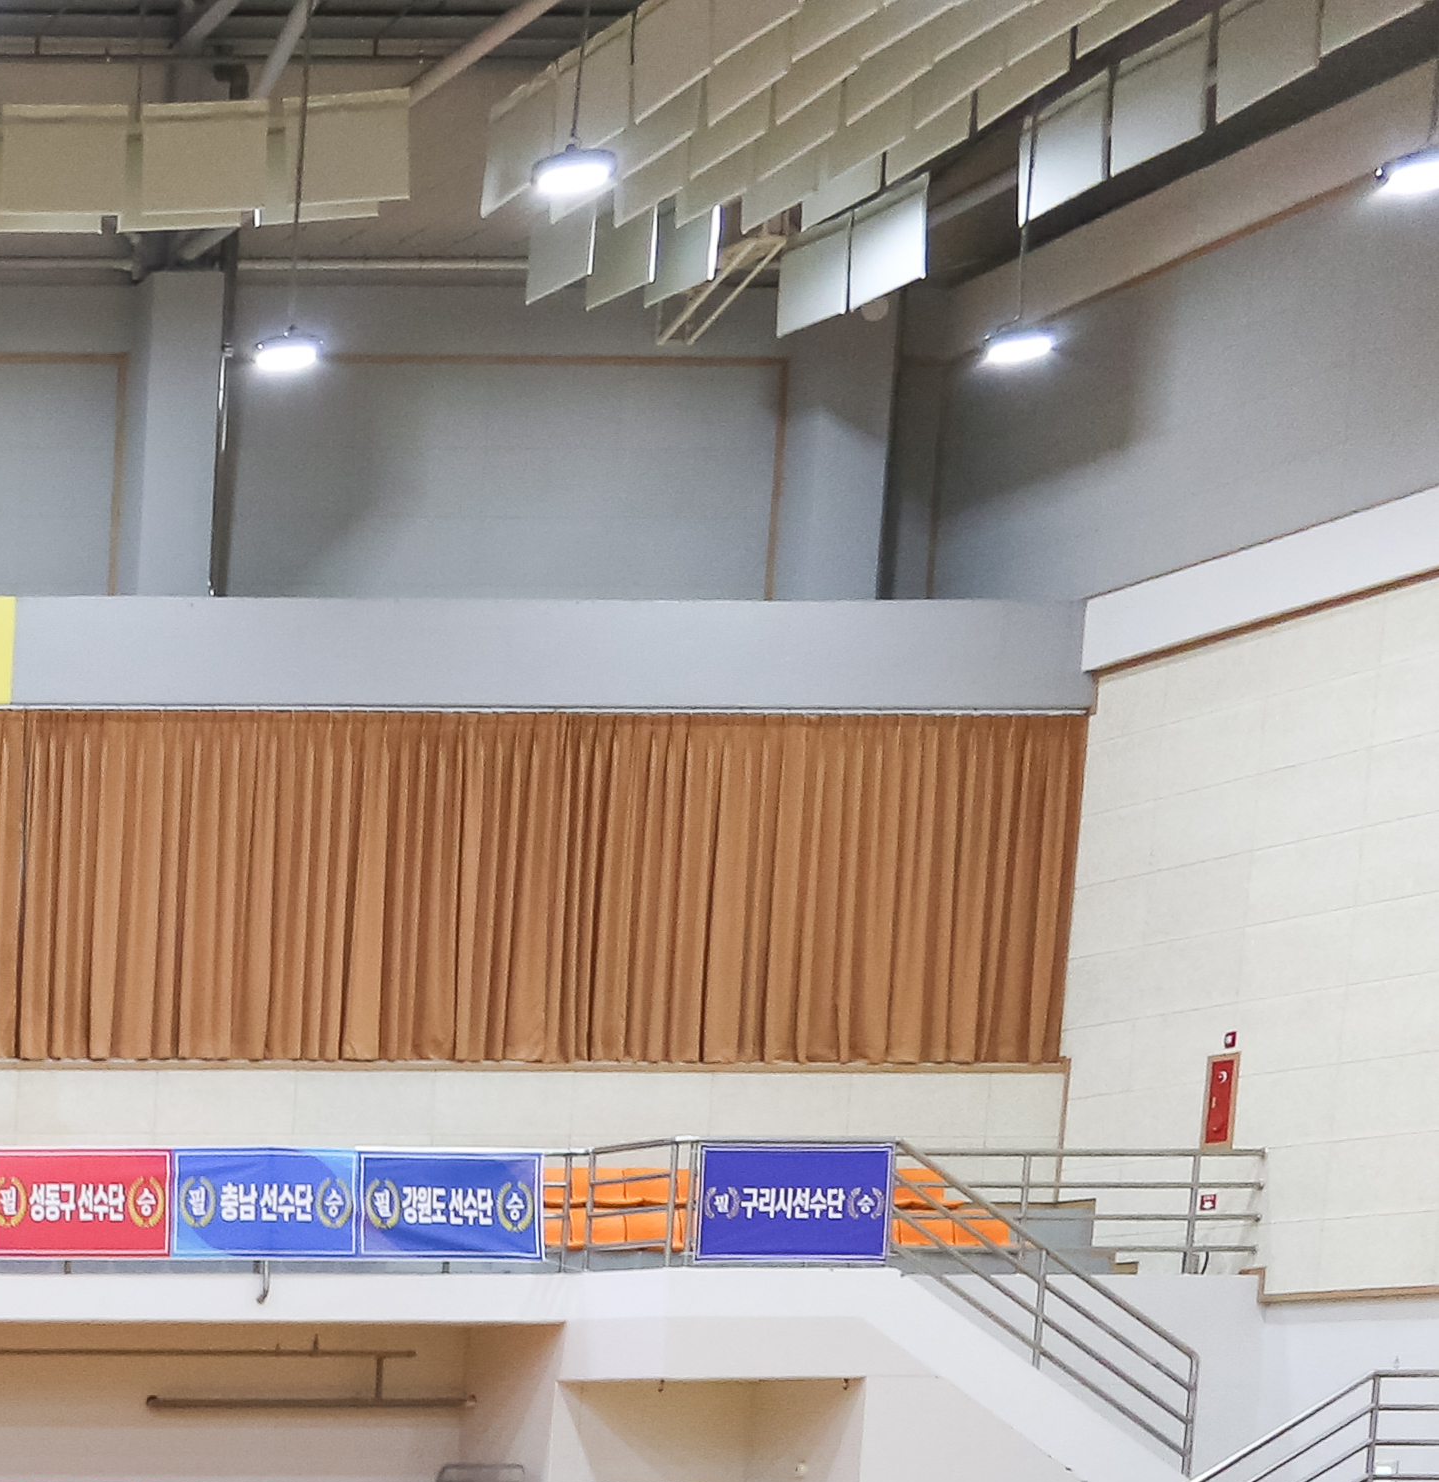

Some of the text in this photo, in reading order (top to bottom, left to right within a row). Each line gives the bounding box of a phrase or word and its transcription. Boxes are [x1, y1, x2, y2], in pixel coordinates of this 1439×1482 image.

[0, 1183, 157, 1222] 필 성동구 선수단 승
[188, 1181, 344, 1222] 필 충남 선수단 승
[374, 1186, 525, 1226] 필 강원도 선수단 승
[855, 1193, 874, 1214] 승
